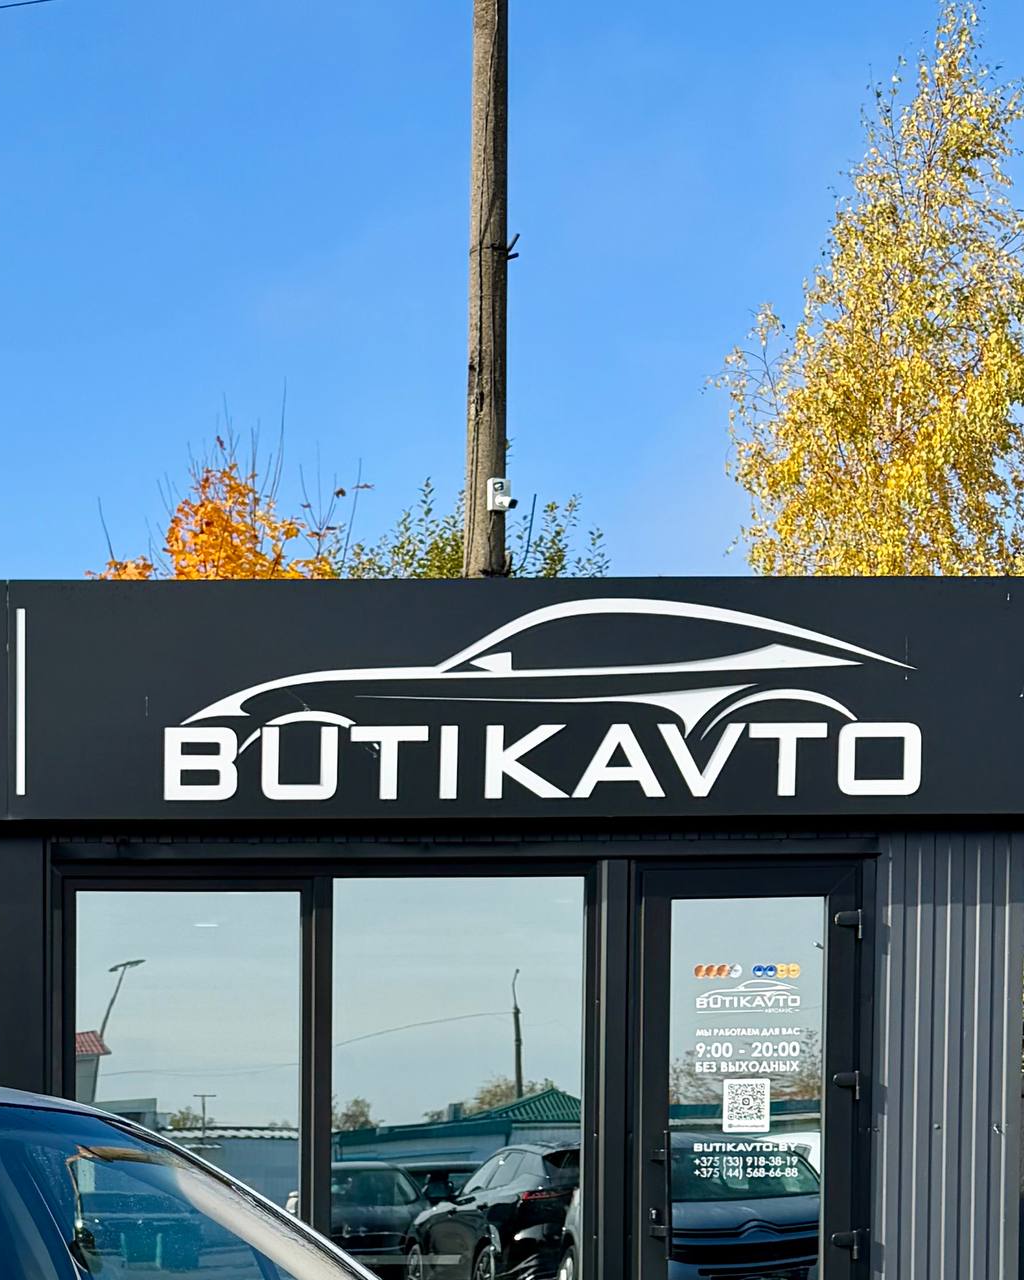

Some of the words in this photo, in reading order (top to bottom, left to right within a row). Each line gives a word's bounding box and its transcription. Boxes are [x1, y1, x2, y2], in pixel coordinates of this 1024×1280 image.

[163, 721, 923, 801] BUTIKAVTO
[695, 995, 801, 1009] BUTIKAVTO
[695, 1029, 713, 1038] МЫ
[712, 1027, 761, 1037] РАБОТАЕМ
[760, 1027, 781, 1037] ДЛЯ
[781, 1026, 801, 1036] ВАС
[695, 1042, 733, 1058] 9:00
[750, 1041, 801, 1058] 20:00
[695, 1062, 717, 1073] БЕЗ
[720, 1060, 800, 1074] ВЫХОДНЫХ
[693, 1142, 799, 1153] BUTIKAVTO.BY
[693, 1156, 720, 1168] +375
[722, 1156, 744, 1170] (33)
[745, 1156, 799, 1168] 918-38-19
[693, 1168, 720, 1179] +375
[722, 1167, 744, 1180] (44)
[745, 1167, 799, 1178] 568-66-88
